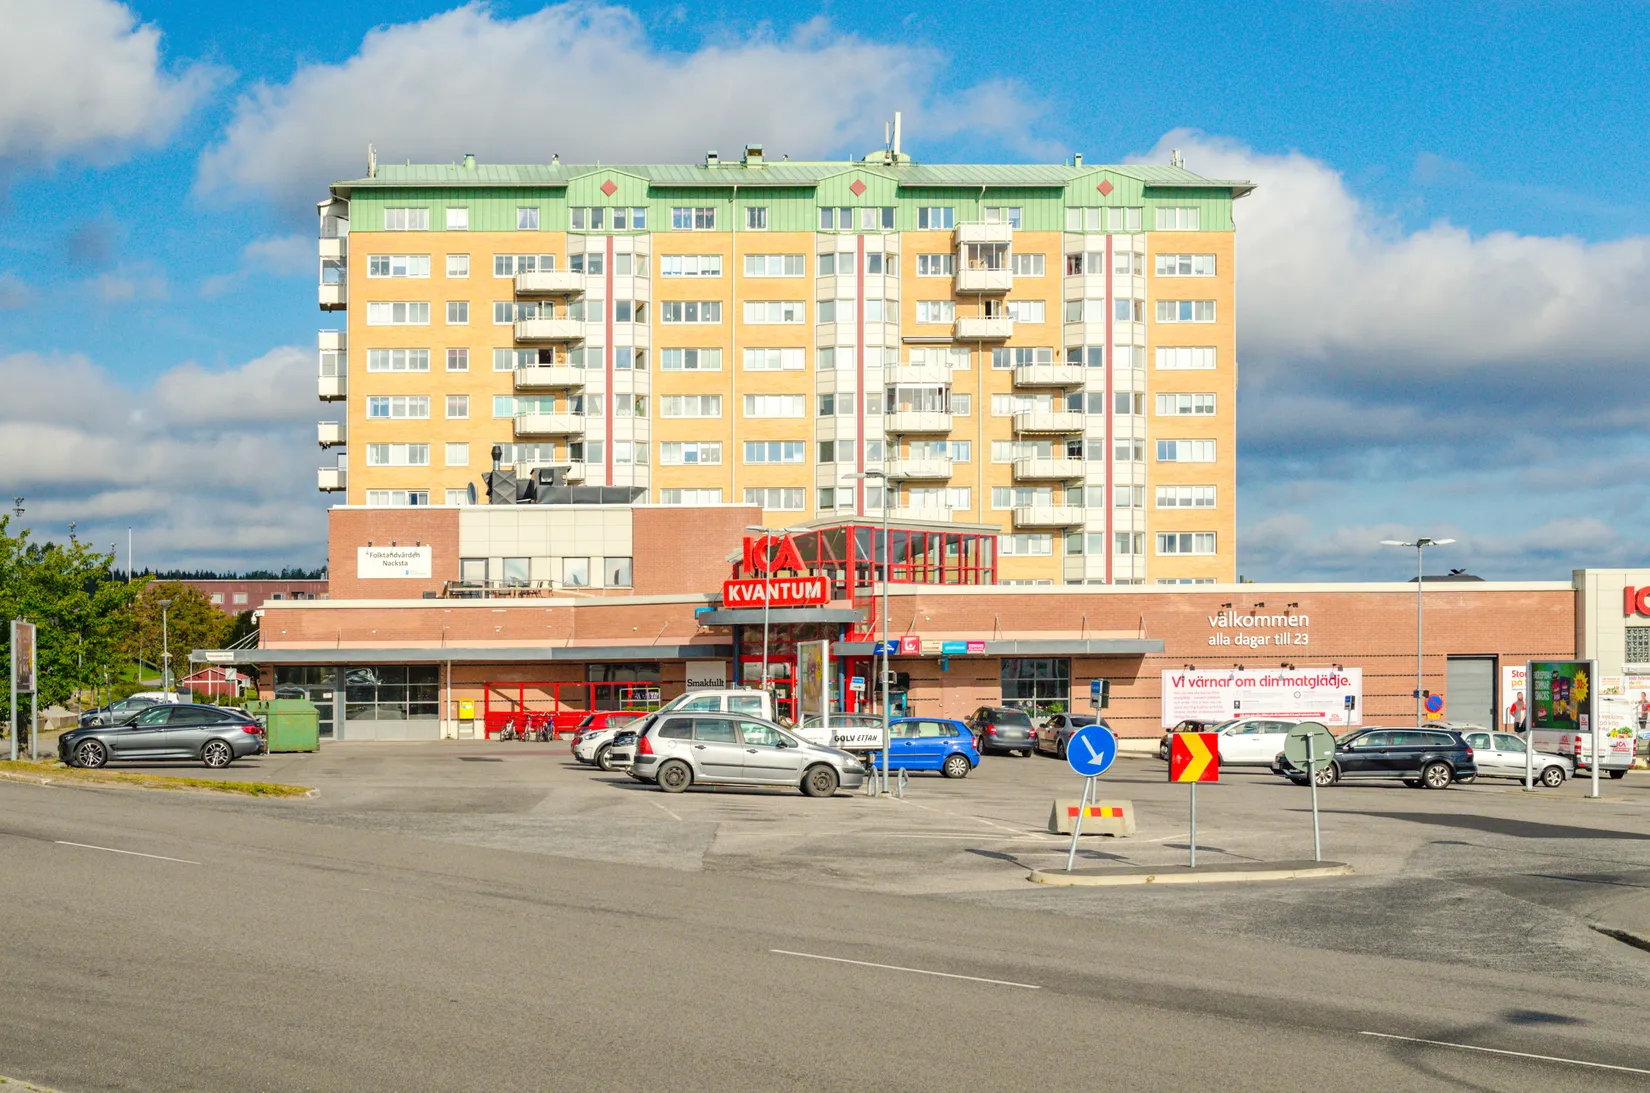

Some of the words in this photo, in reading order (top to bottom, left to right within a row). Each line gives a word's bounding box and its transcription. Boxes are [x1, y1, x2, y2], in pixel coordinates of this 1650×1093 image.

[369, 551, 421, 559] Folktandvården
[743, 534, 806, 573] ICA
[728, 581, 822, 602] KVANTUM
[1623, 585, 1650, 616] IC
[1208, 610, 1310, 628] välkommen
[1208, 632, 1231, 646] alla
[1234, 632, 1271, 649] dagar
[1274, 632, 1291, 645] till
[1293, 633, 1309, 645] 23
[687, 678, 724, 687] Smakfullt
[1171, 675, 1185, 688] Vi
[1188, 675, 1232, 688] värnar
[1235, 678, 1256, 687] om
[1259, 675, 1280, 687] din
[1282, 674, 1352, 690] matglädje.
[834, 734, 856, 742] GOLV
